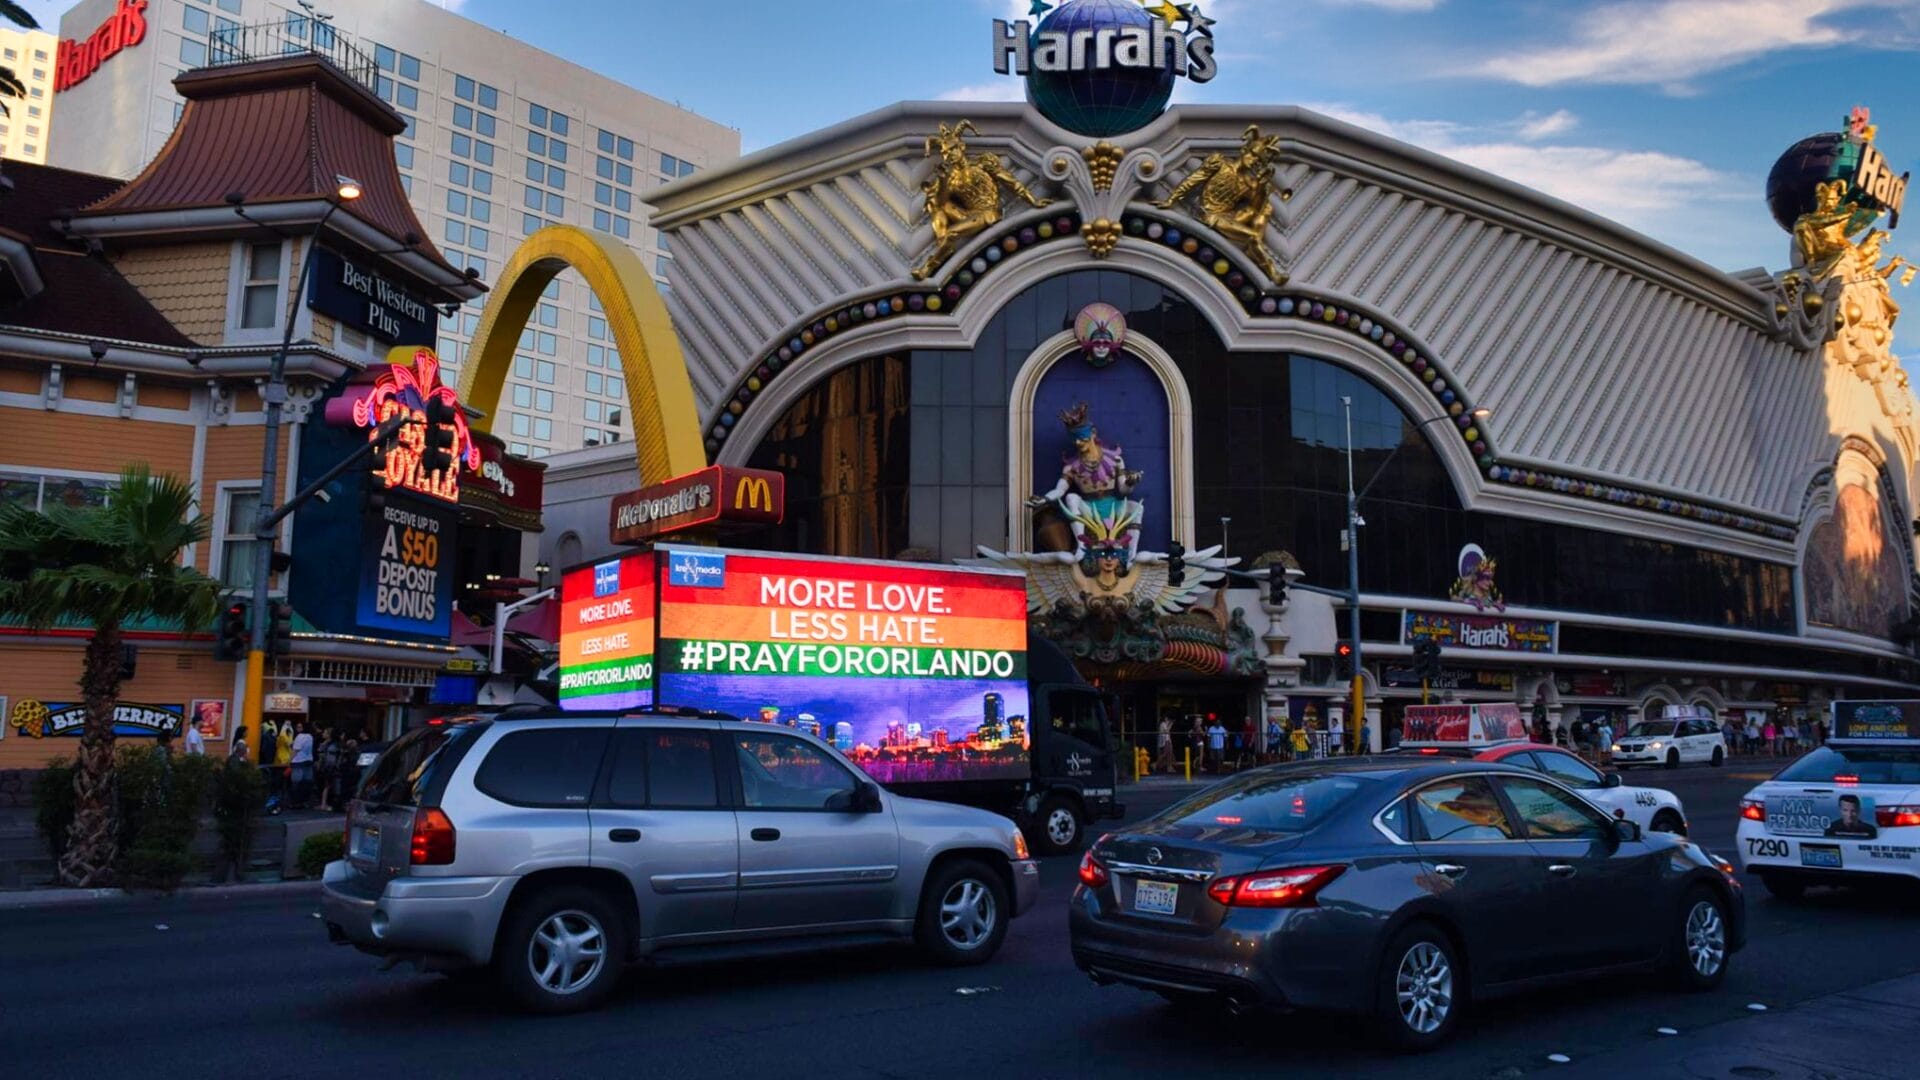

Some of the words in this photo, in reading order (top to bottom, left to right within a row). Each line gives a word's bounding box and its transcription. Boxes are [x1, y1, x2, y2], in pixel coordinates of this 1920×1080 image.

[343, 261, 374, 296] Best
[376, 278, 426, 323] Western
[368, 302, 400, 338] Plus
[384, 506, 417, 527] RECEIVE
[417, 512, 428, 529] UP
[428, 517, 439, 532] TO
[616, 484, 711, 528] McDonald's
[381, 524, 399, 560] A
[402, 527, 438, 568] $50
[378, 560, 437, 594] DEPOSIT
[376, 585, 436, 621] BONUS
[760, 576, 856, 610] MORE
[866, 581, 952, 615] LOVE.
[580, 603, 606, 625] MORE
[769, 610, 848, 640] LESS
[857, 614, 945, 644] HATE.
[582, 639, 603, 655] LESS
[1460, 622, 1509, 647] Harrah's
[560, 662, 653, 690] #PRAYFORORLANDO
[680, 641, 1014, 678] #PRAYFORORLANDO
[1767, 813, 1831, 830] FRANCO
[1746, 838, 1790, 858] 7290
